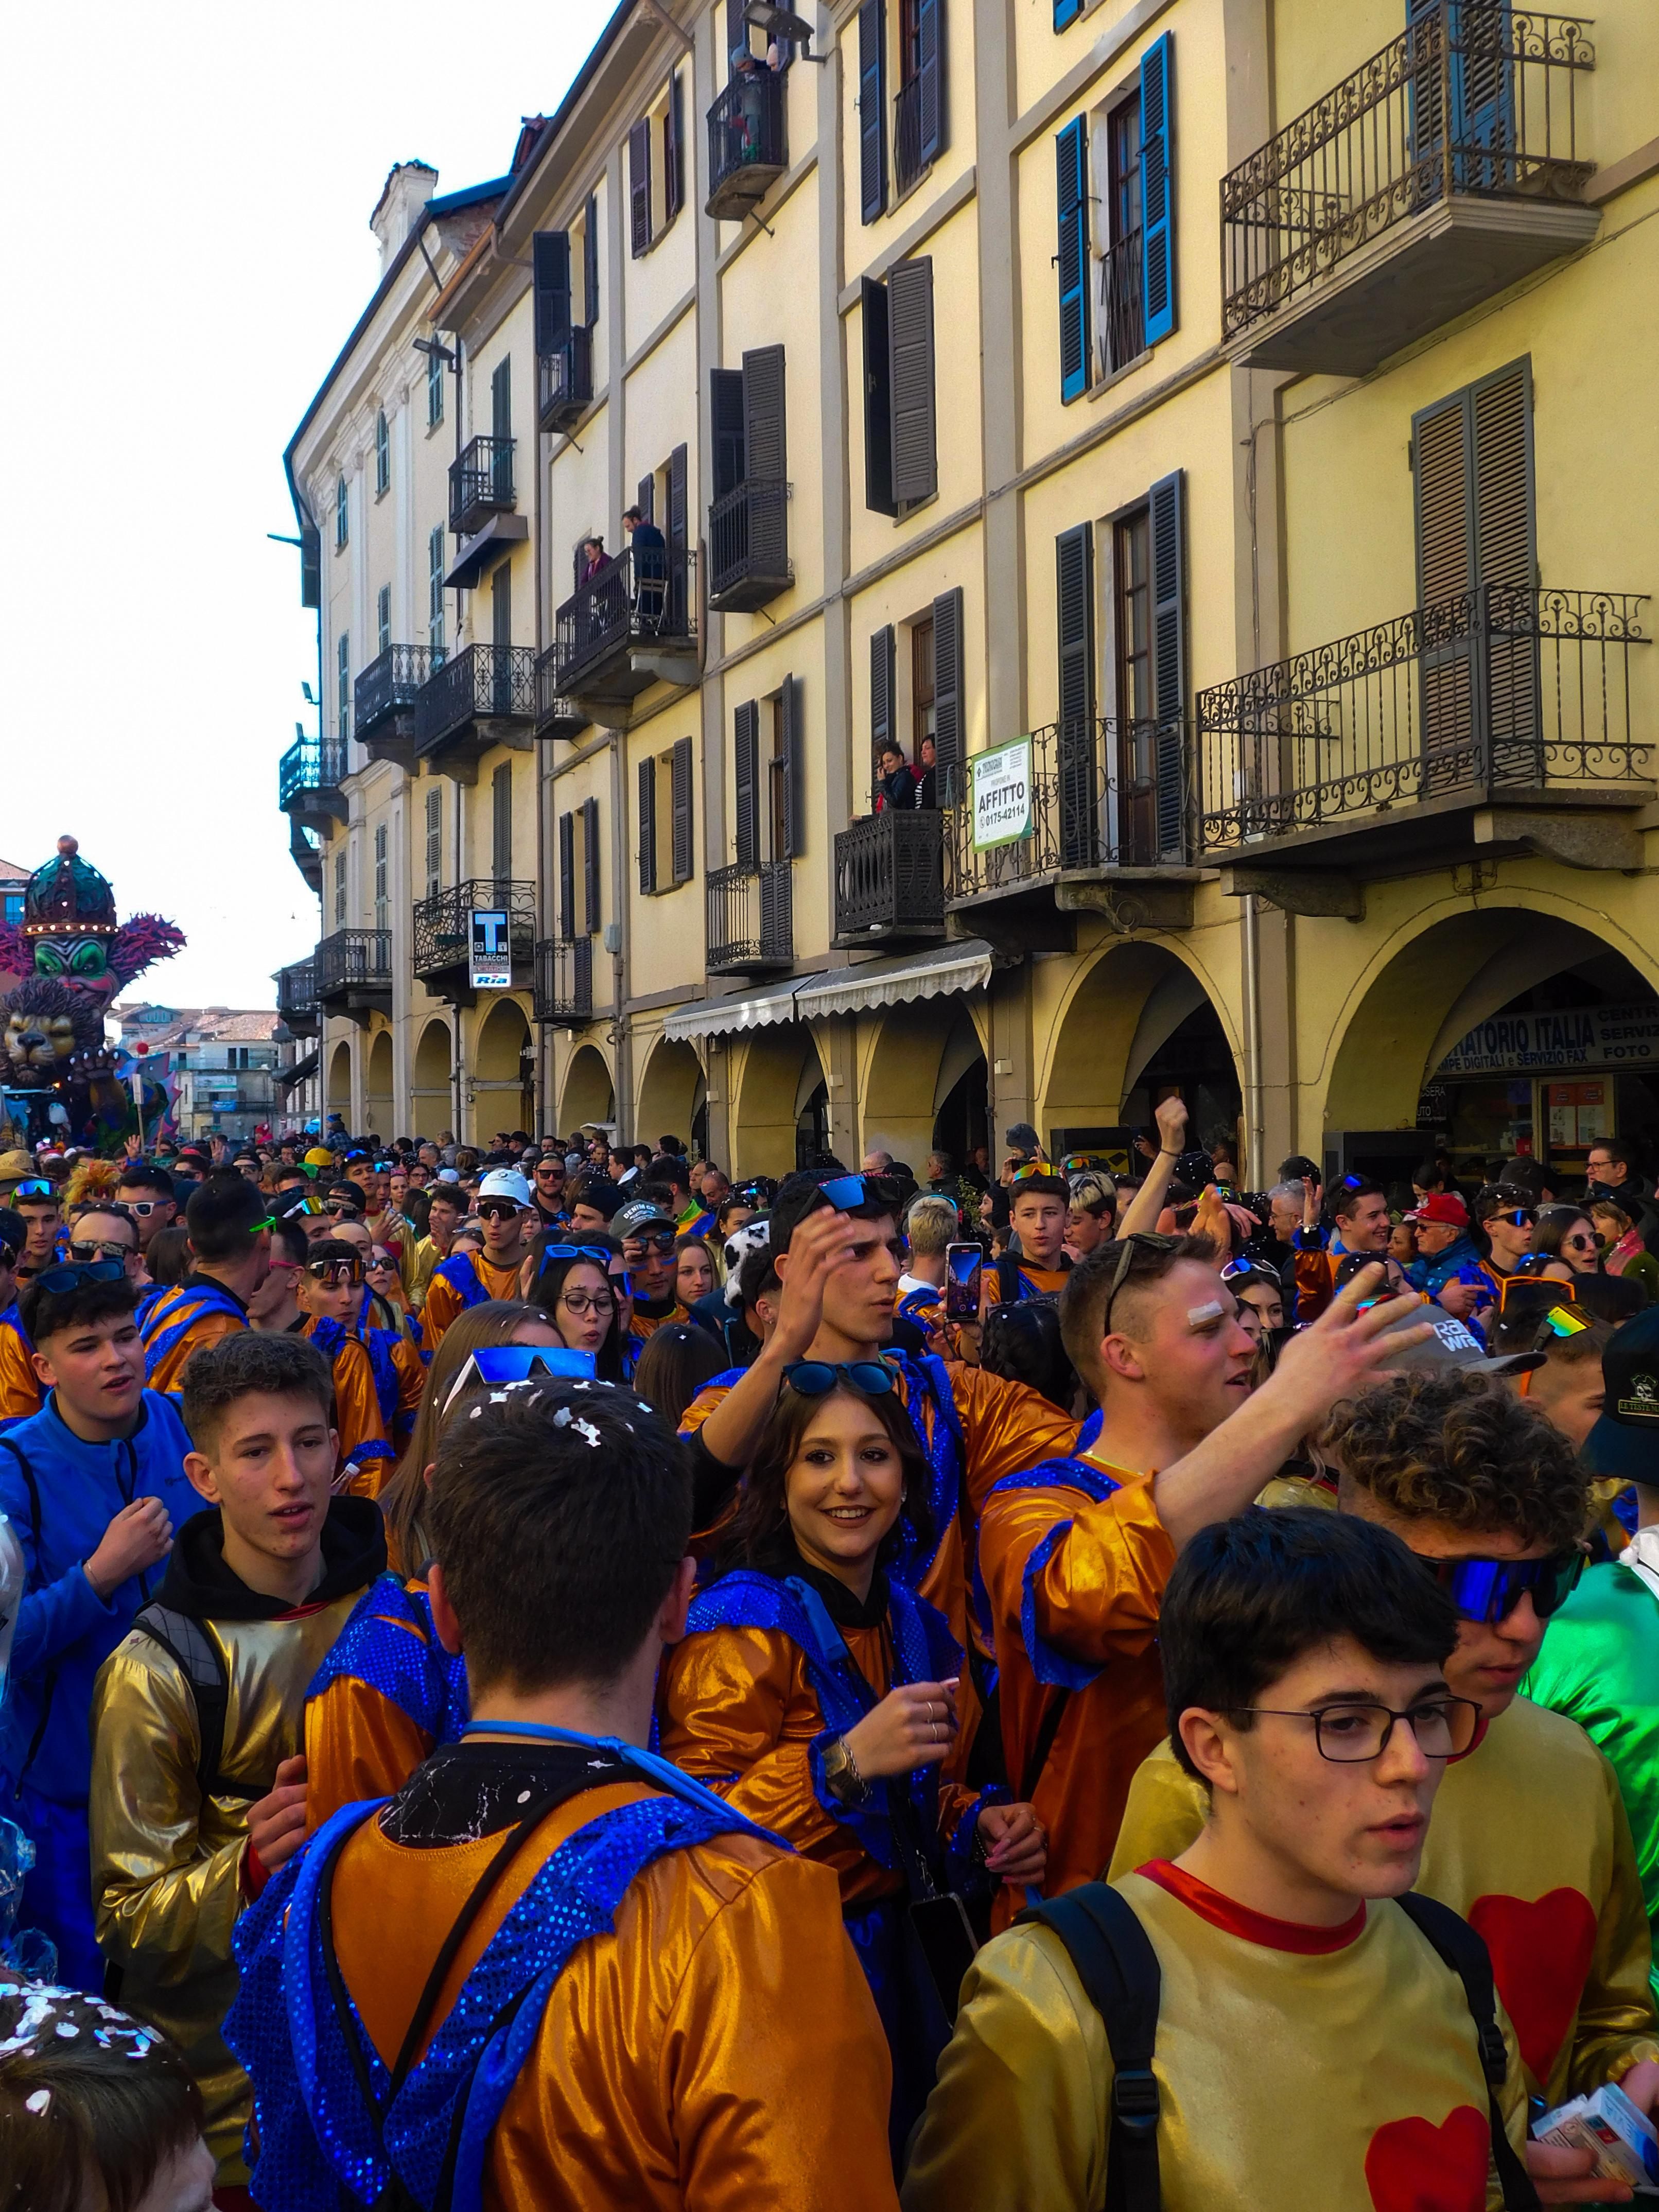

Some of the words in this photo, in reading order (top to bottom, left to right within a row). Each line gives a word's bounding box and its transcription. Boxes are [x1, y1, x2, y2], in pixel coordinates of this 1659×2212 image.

[979, 781, 1025, 813] AFFITTO
[986, 803, 1025, 826] 0175-42114
[475, 913, 505, 952] T
[476, 974, 507, 983] Ria
[1597, 1005, 1659, 1022] CENTR
[1535, 1014, 1596, 1051] ITALIA
[1438, 1058, 1461, 1071] MPE
[1463, 1054, 1505, 1069] DIGITALI
[1508, 1057, 1514, 1066] e
[1516, 1051, 1564, 1067] SERVIZIO
[1566, 1049, 1588, 1063] FAX
[1603, 1044, 1651, 1058] FOTO
[623, 1204, 645, 1220] DENIM
[645, 1205, 658, 1213] CO.
